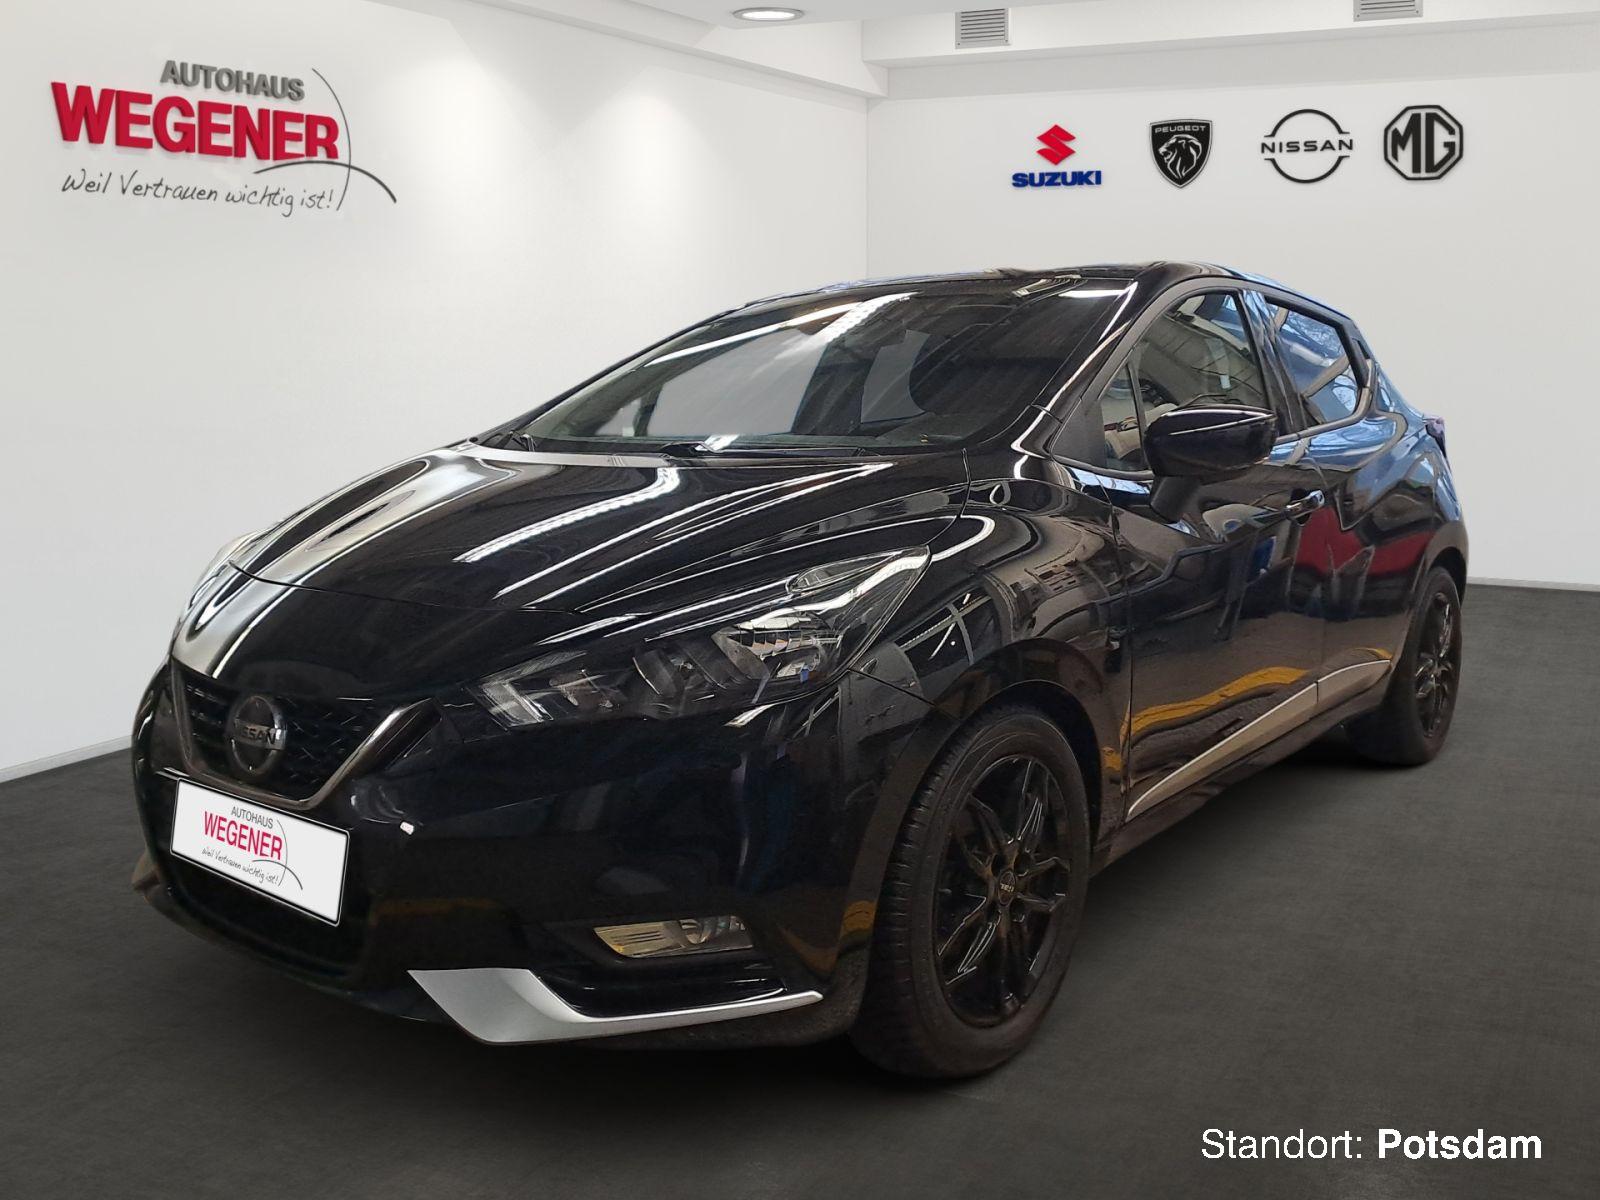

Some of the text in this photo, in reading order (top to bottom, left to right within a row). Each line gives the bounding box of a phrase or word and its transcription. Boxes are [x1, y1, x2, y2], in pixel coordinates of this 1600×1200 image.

[160, 59, 305, 102] AUTOHAUS
[51, 81, 339, 161] WEGENER
[1154, 124, 1206, 134] PEUGEOT
[1261, 138, 1354, 155] NISSAN
[1391, 112, 1456, 174] MG
[61, 168, 334, 218] Weil Vertrauen wichtig ist!
[1011, 170, 1102, 188] SUZUKI
[233, 721, 277, 745] SSAN
[231, 806, 274, 829] AUTOHAUS
[204, 811, 283, 860] WEGENER
